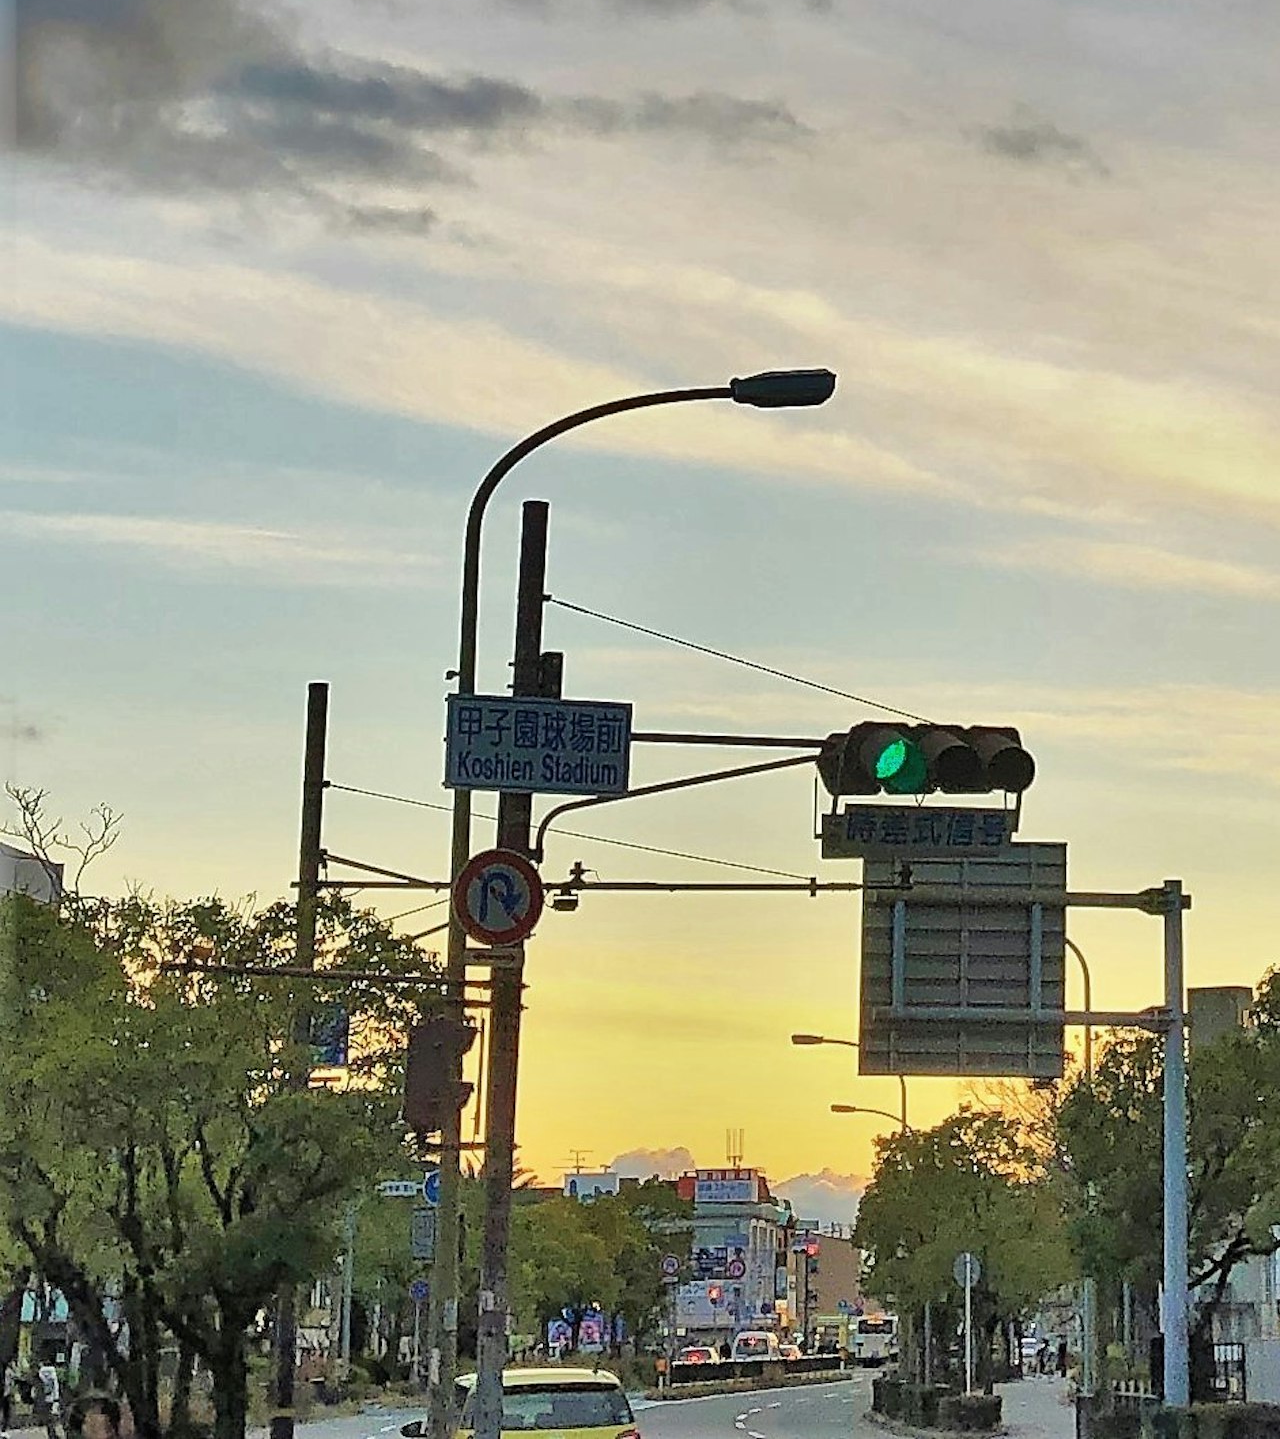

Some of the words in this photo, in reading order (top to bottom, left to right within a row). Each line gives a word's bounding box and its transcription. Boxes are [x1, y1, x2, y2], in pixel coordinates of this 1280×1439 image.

[458, 706, 622, 754] 甲子園球場前
[457, 750, 534, 781] Koshien
[541, 753, 618, 786] Stadium
[846, 811, 1007, 847] 時差式信号
